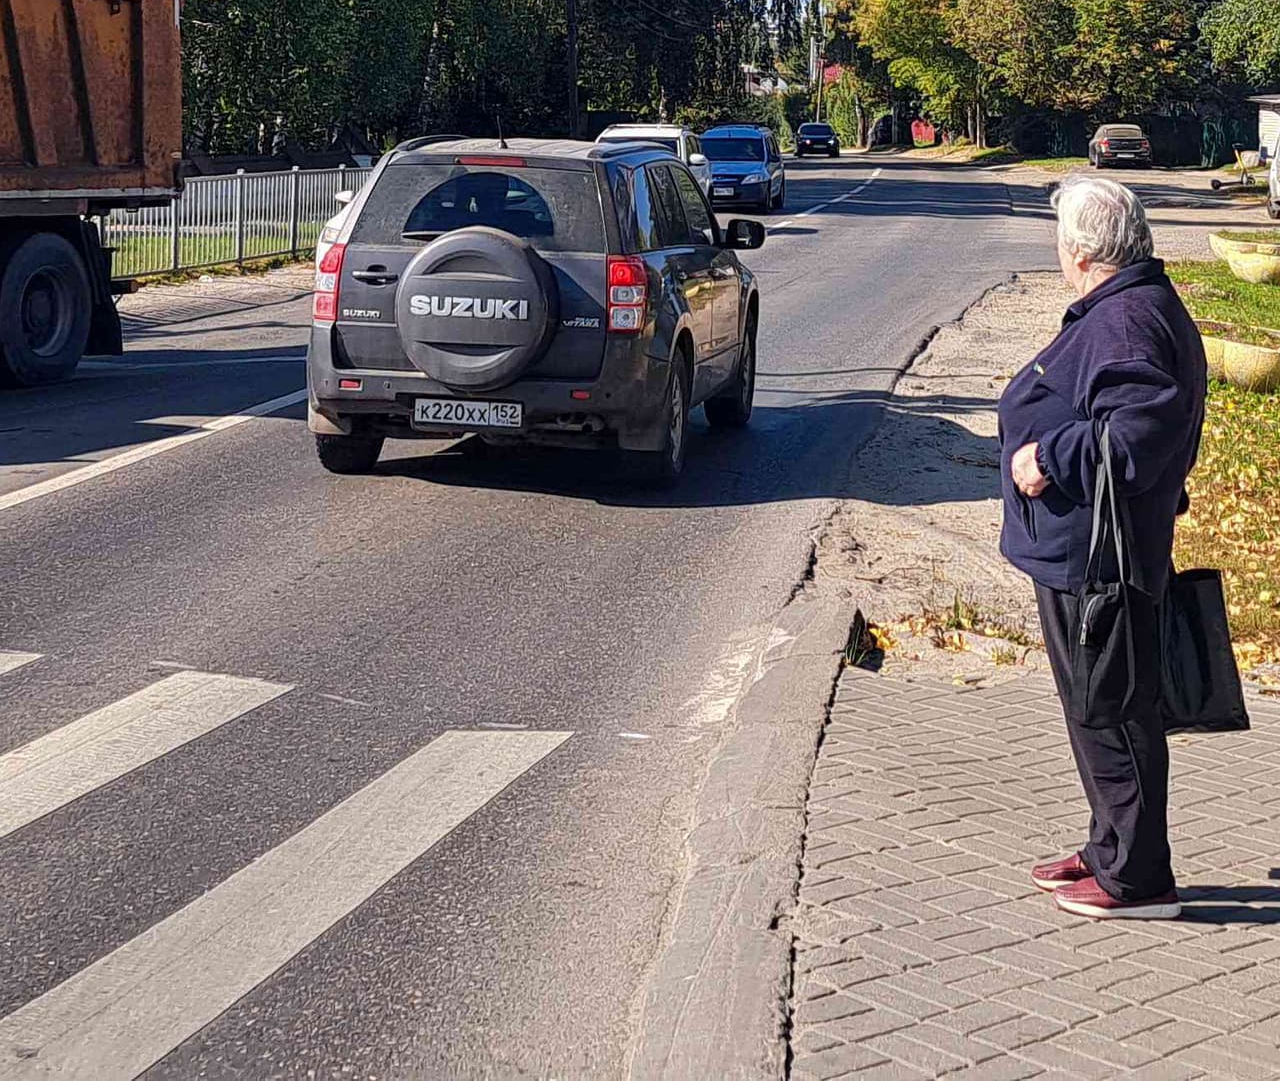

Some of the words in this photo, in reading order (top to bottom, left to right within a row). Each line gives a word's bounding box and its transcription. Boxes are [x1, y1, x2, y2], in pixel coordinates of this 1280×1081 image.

[342, 309, 381, 319] SUZUKI
[410, 295, 528, 320] SUZUKI
[420, 403, 488, 423] К220ХХ
[491, 404, 519, 419] 152
